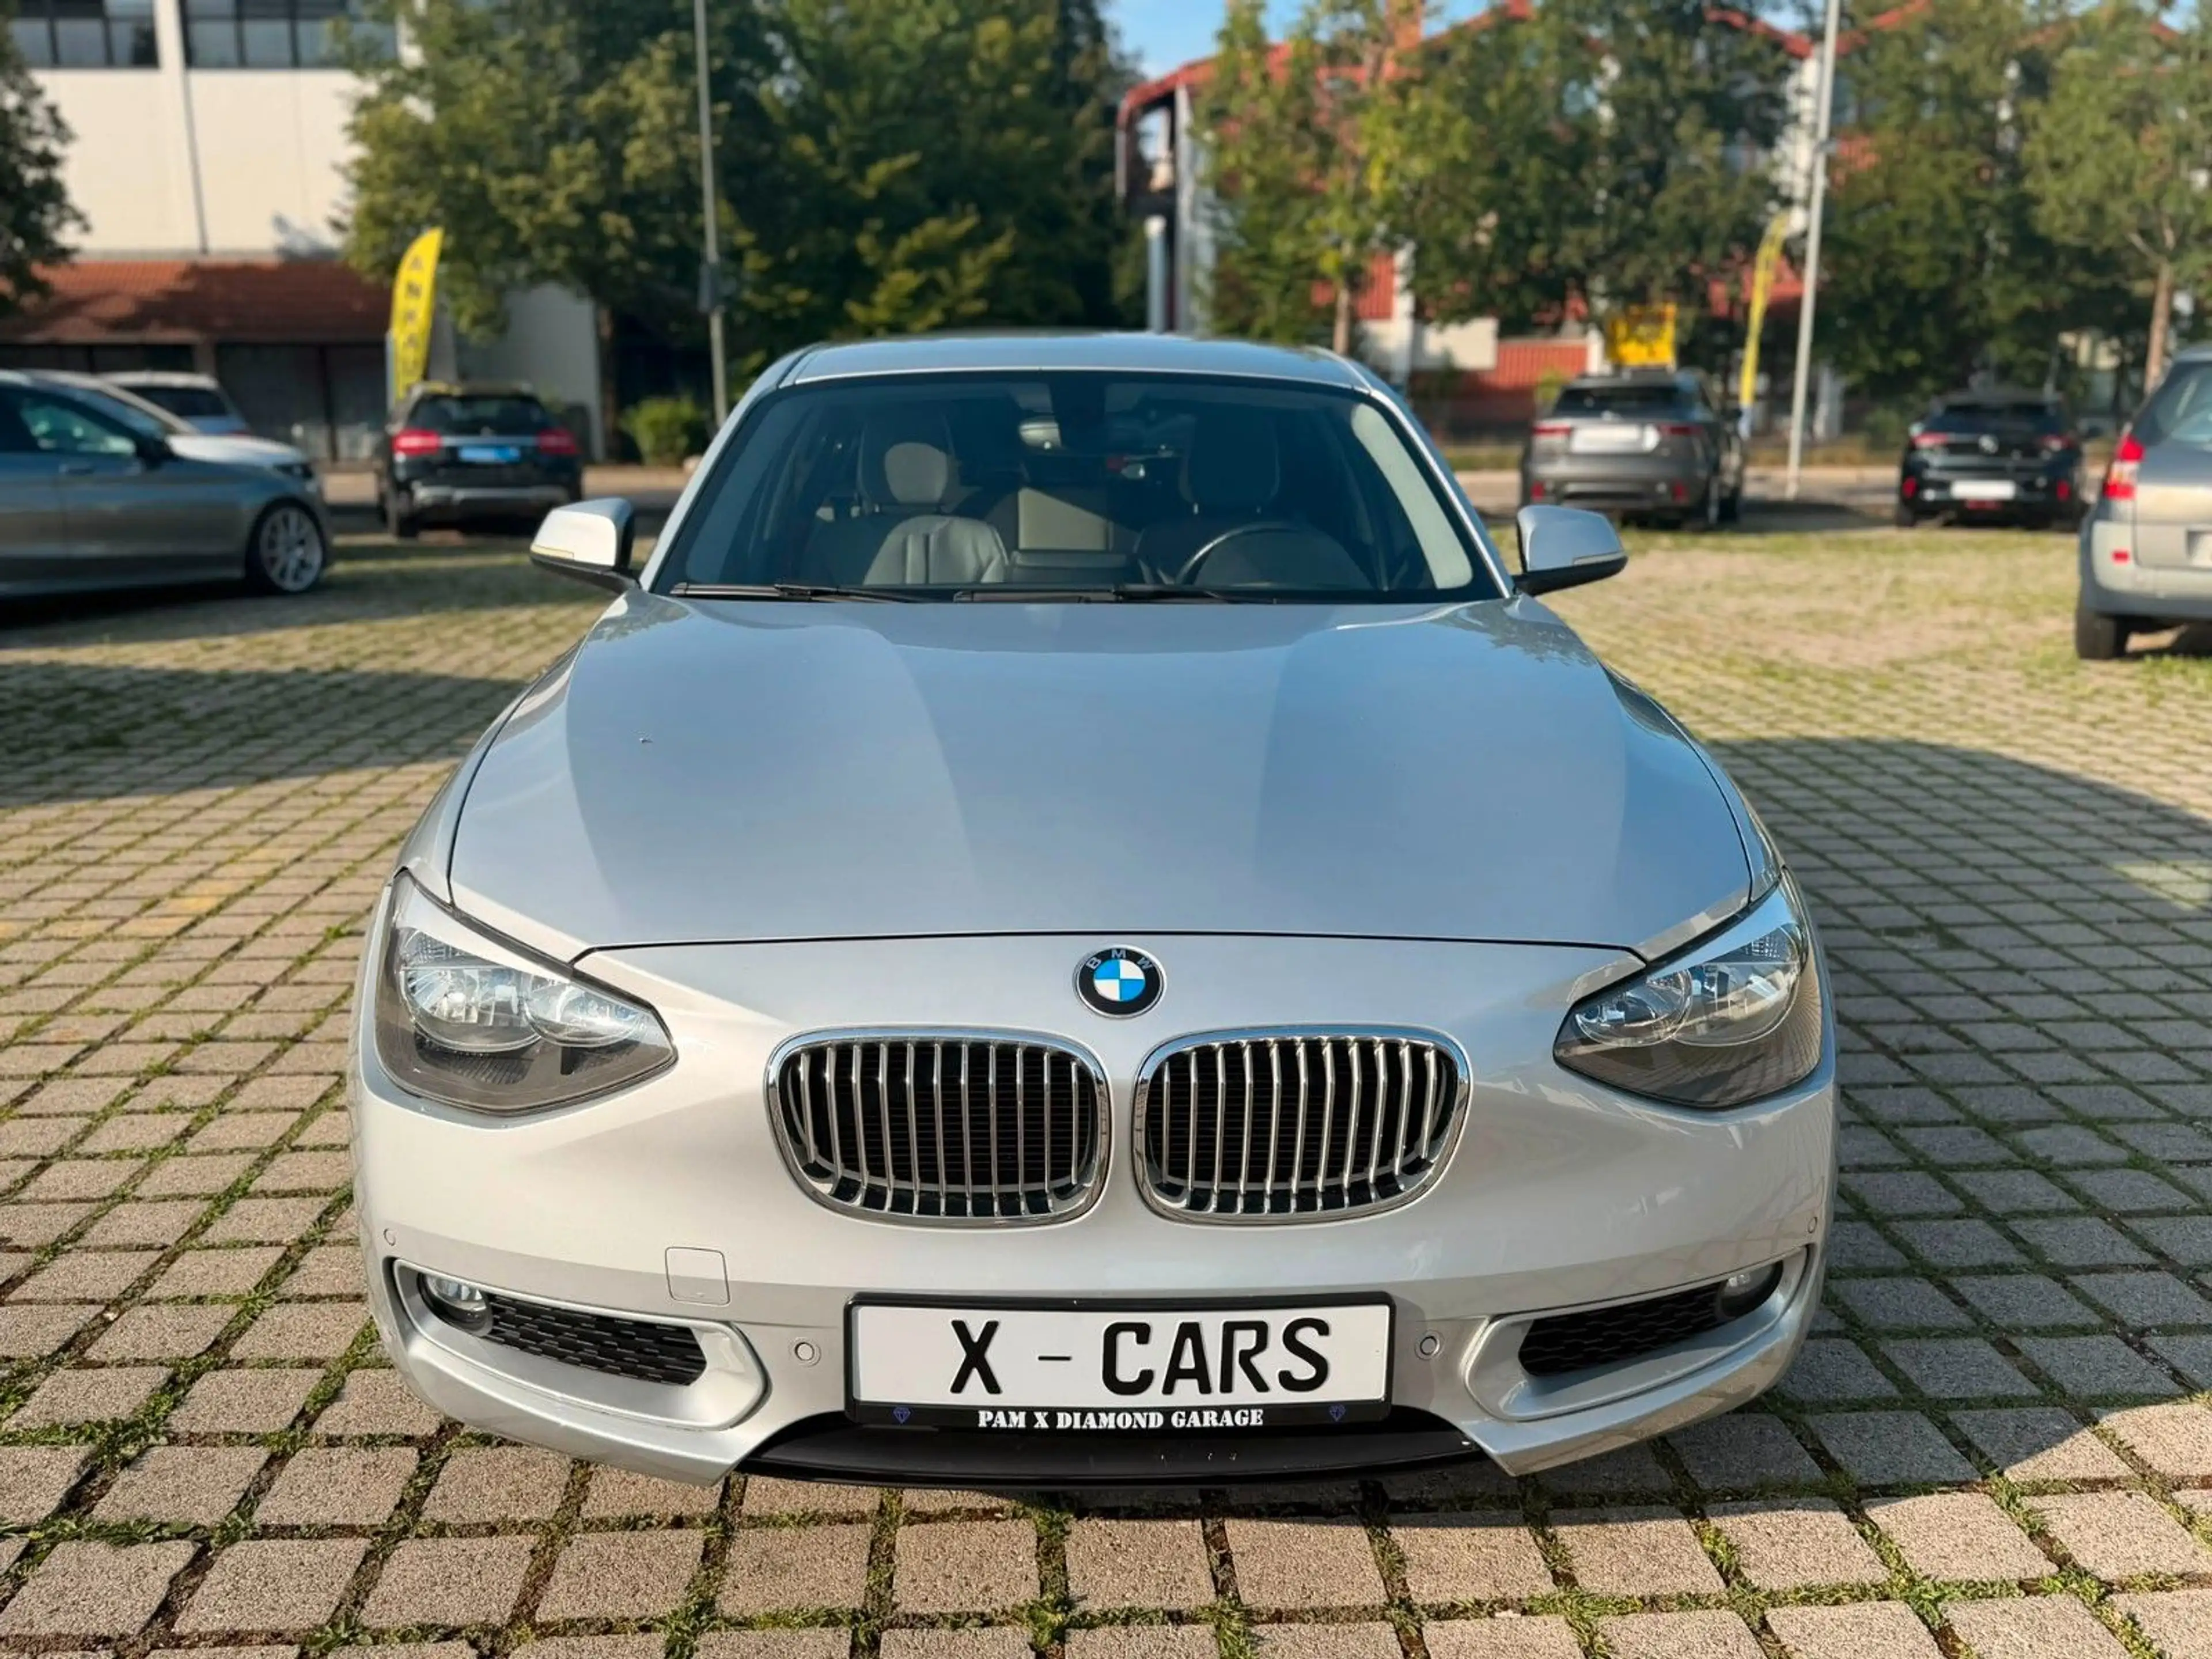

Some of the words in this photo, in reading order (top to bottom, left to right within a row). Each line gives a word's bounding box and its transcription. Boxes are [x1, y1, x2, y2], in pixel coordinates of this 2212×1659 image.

[1086, 948, 1154, 970] BMW
[950, 1320, 1001, 1395] X
[1101, 1317, 1330, 1396] CARS
[978, 1410, 1027, 1429] PAM
[1033, 1411, 1050, 1429] X
[1056, 1411, 1164, 1430] DIAMOND
[1171, 1408, 1264, 1429] GARAGE
